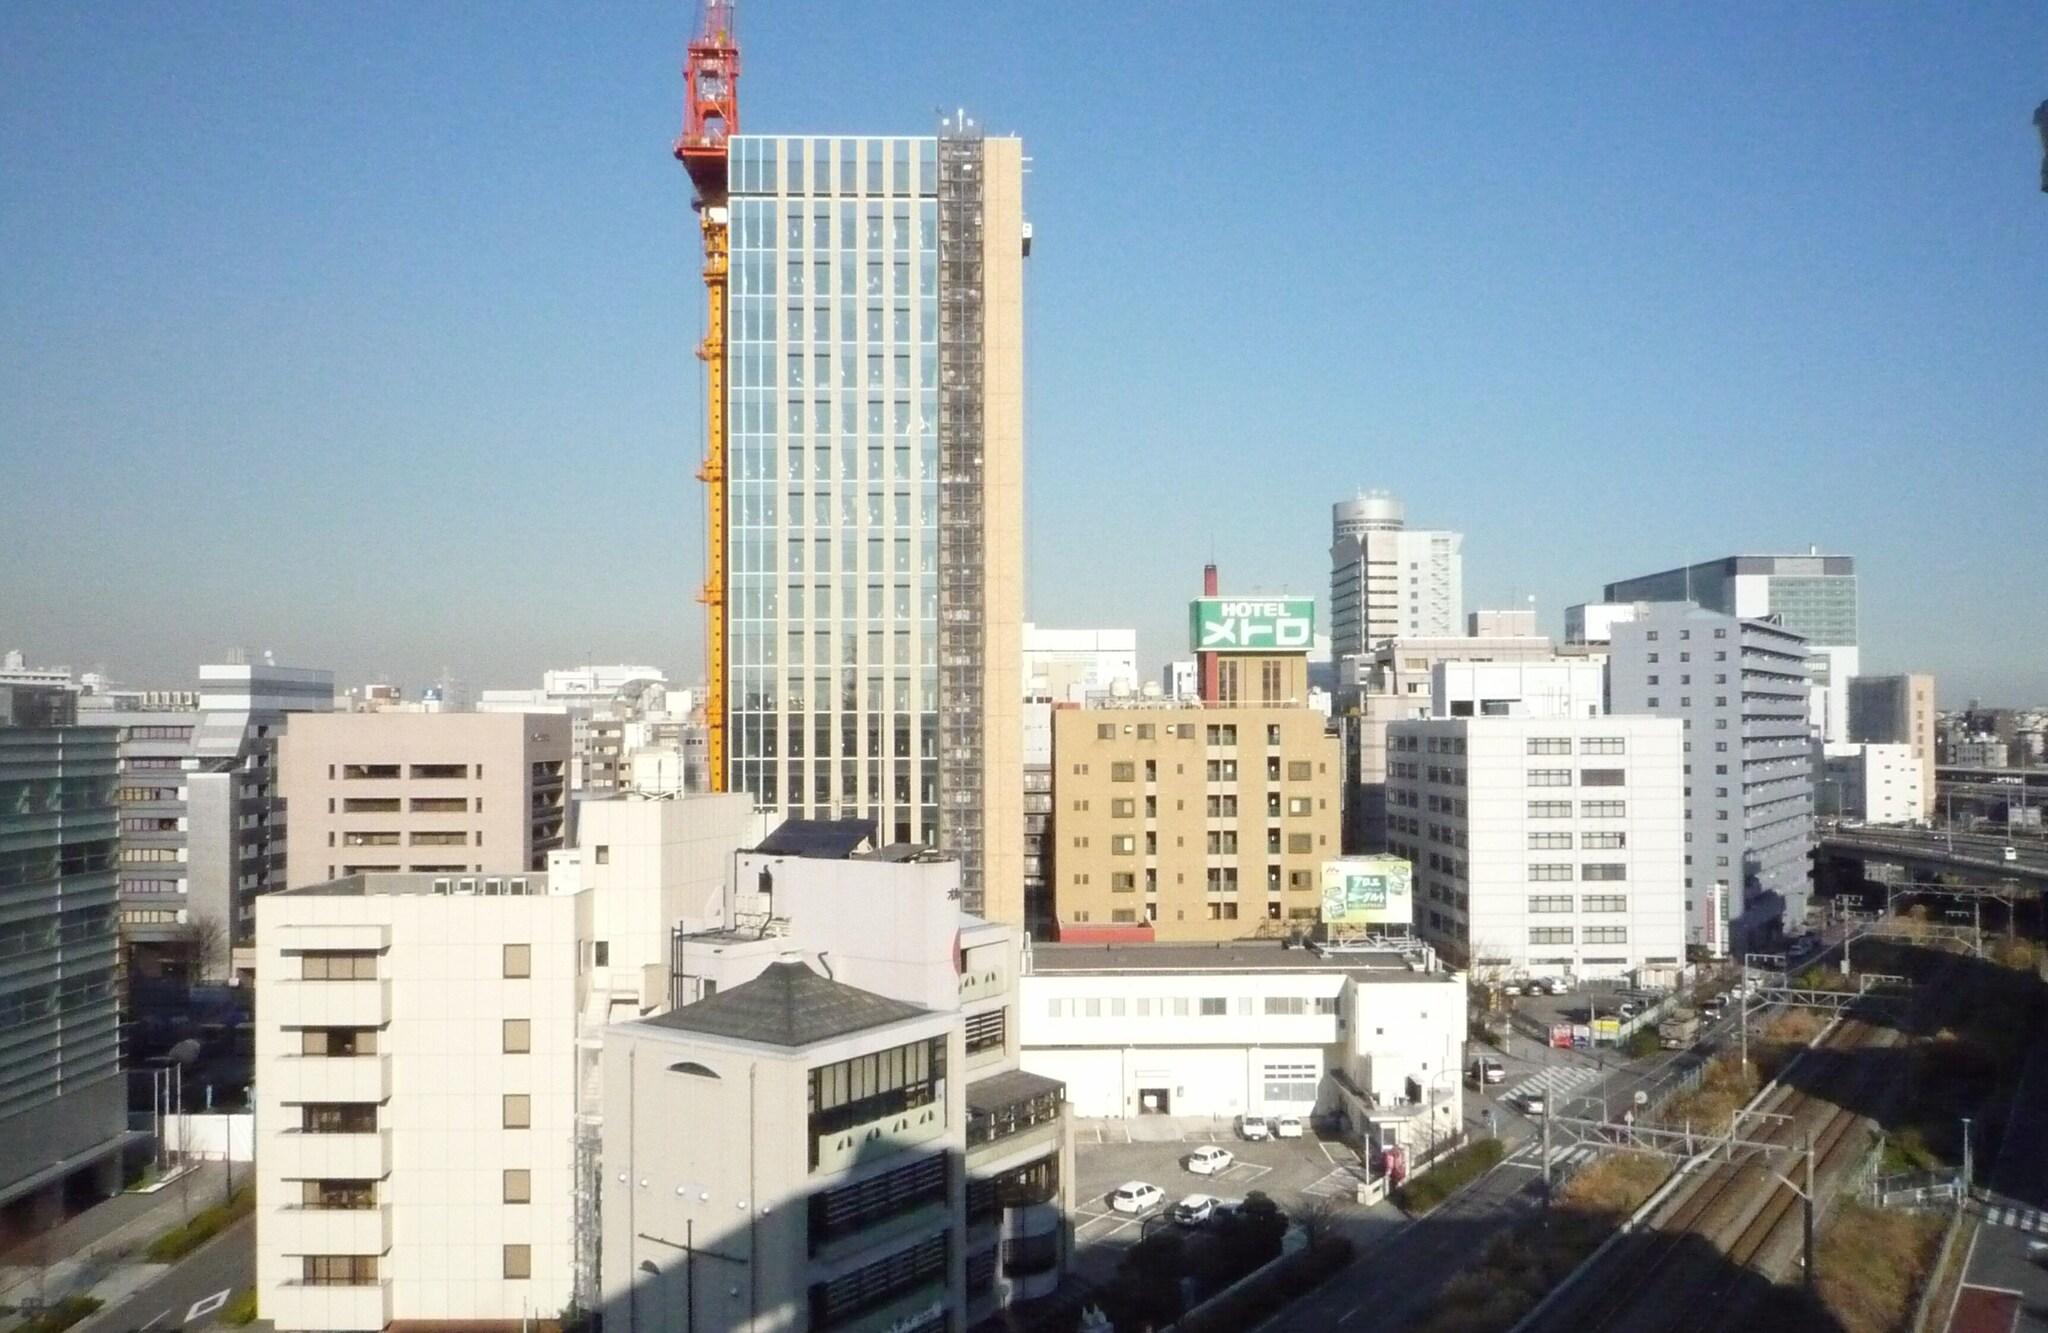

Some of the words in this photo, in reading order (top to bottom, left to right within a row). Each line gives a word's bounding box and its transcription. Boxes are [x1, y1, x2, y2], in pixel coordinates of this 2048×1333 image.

[1221, 602, 1291, 617] HOTEL
[1202, 617, 1310, 645] メトロ
